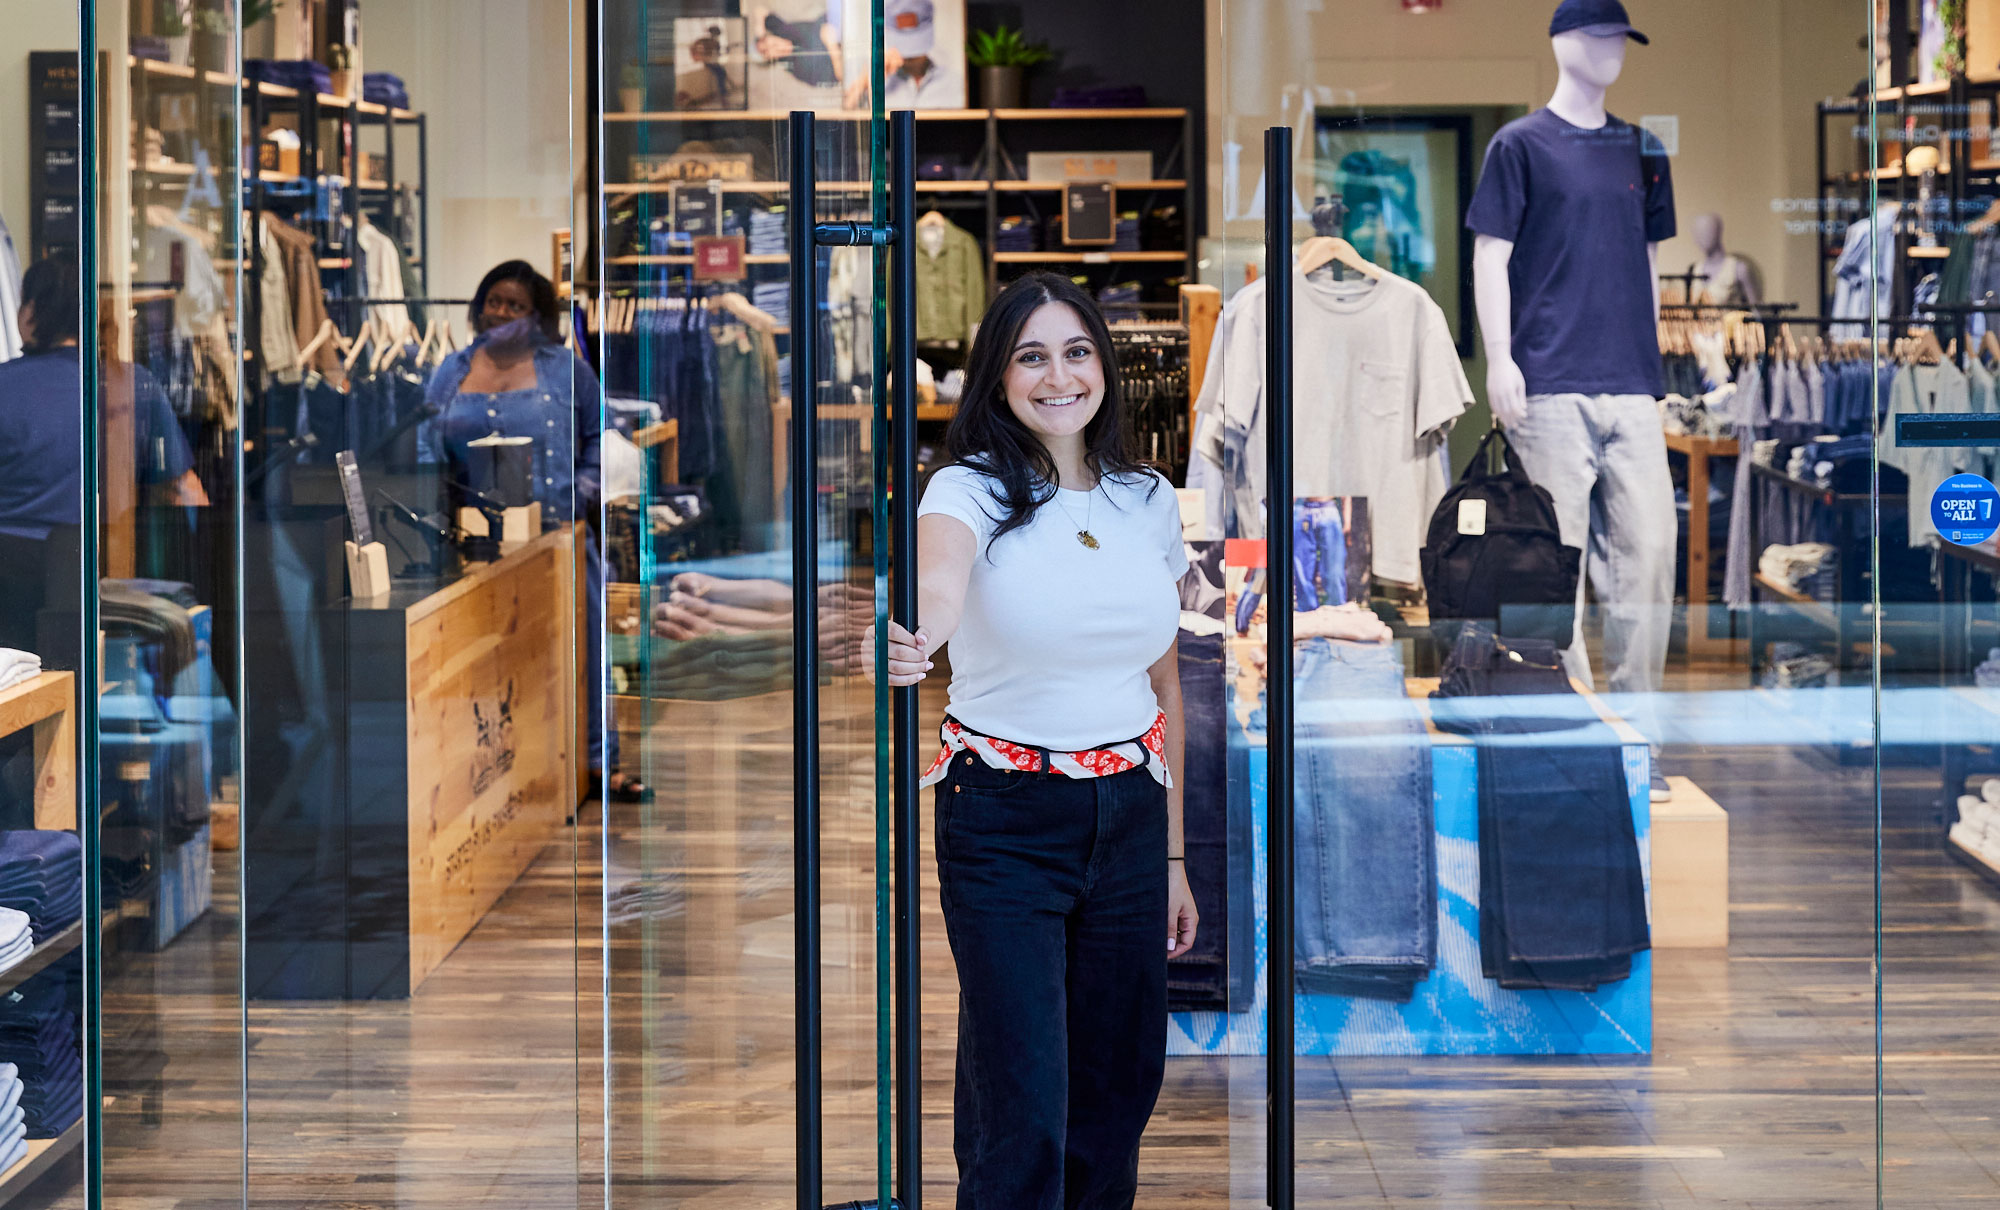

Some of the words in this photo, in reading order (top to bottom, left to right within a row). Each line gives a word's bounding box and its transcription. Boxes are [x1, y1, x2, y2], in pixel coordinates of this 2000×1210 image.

[684, 160, 748, 178] TAPER
[1941, 499, 1976, 510] OPEN
[1952, 510, 1976, 520] ALL
